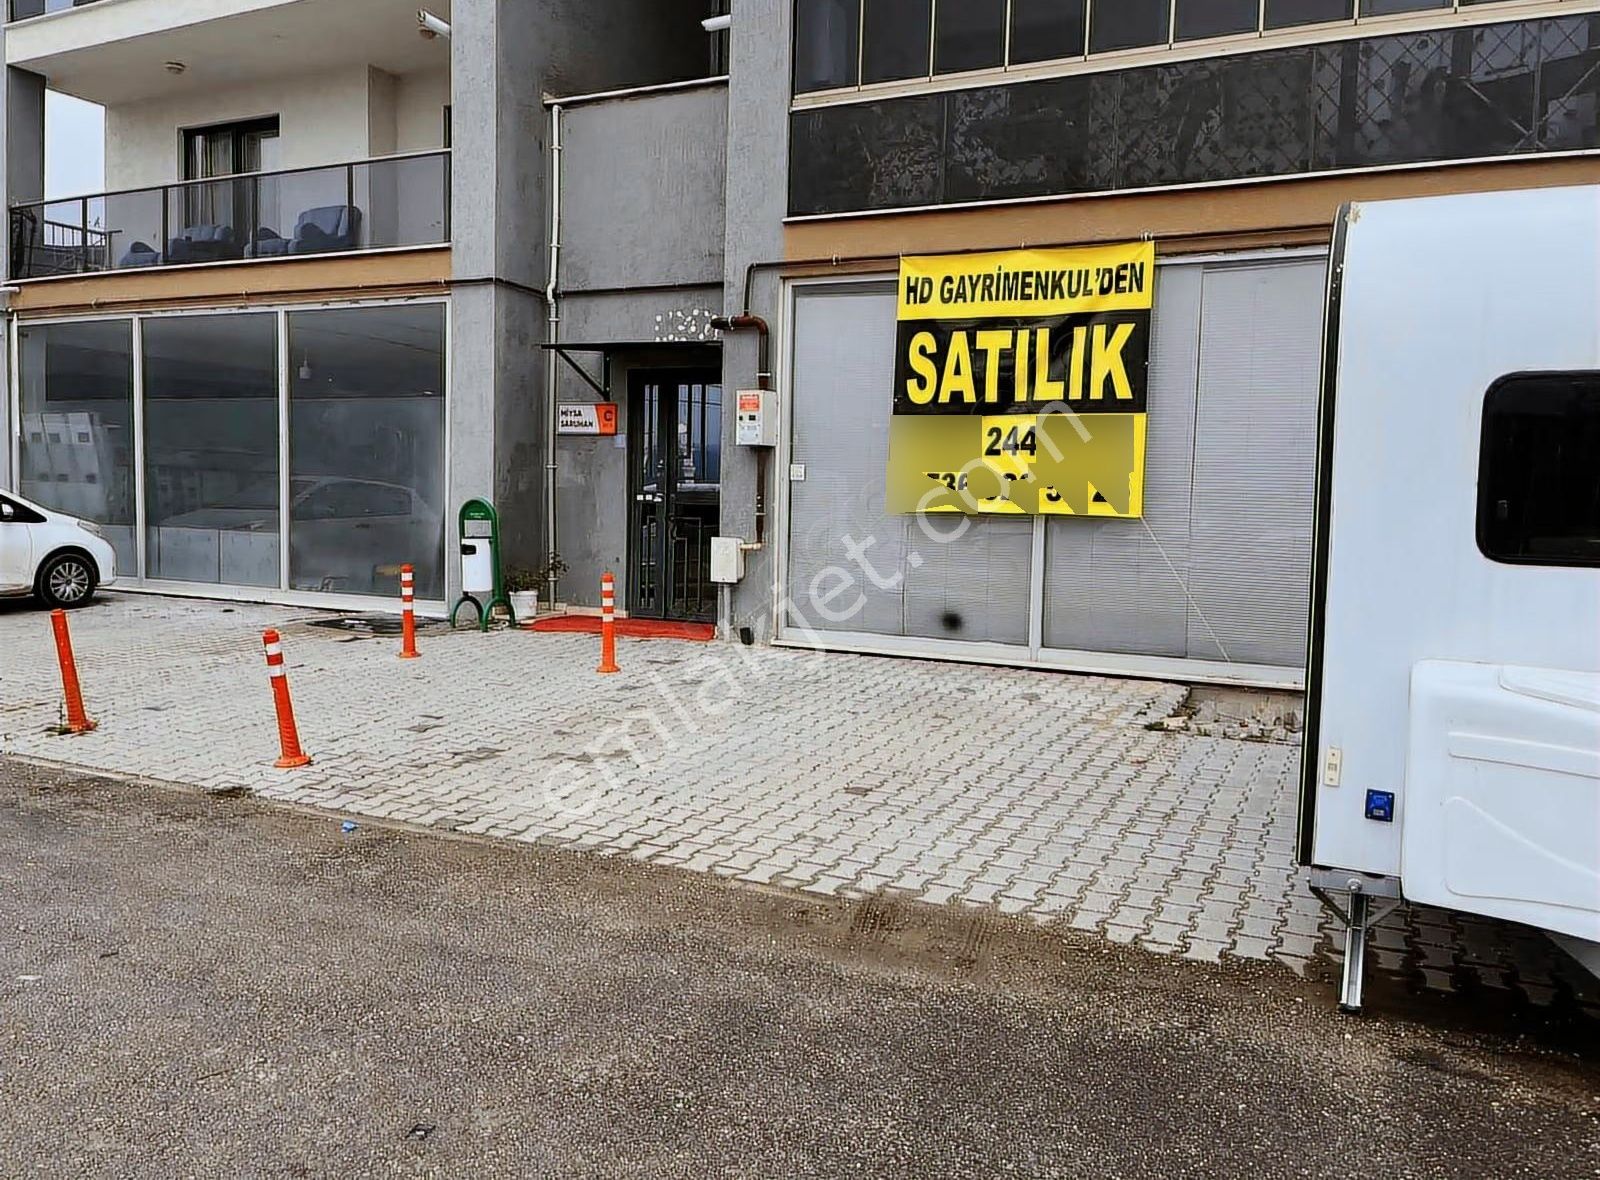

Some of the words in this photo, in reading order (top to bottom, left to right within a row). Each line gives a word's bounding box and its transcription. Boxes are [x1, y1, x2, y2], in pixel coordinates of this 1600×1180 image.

[906, 275, 934, 305] HD
[939, 262, 1145, 304] GAYRİMENKUL'DEN
[906, 323, 1136, 405] SATILIK
